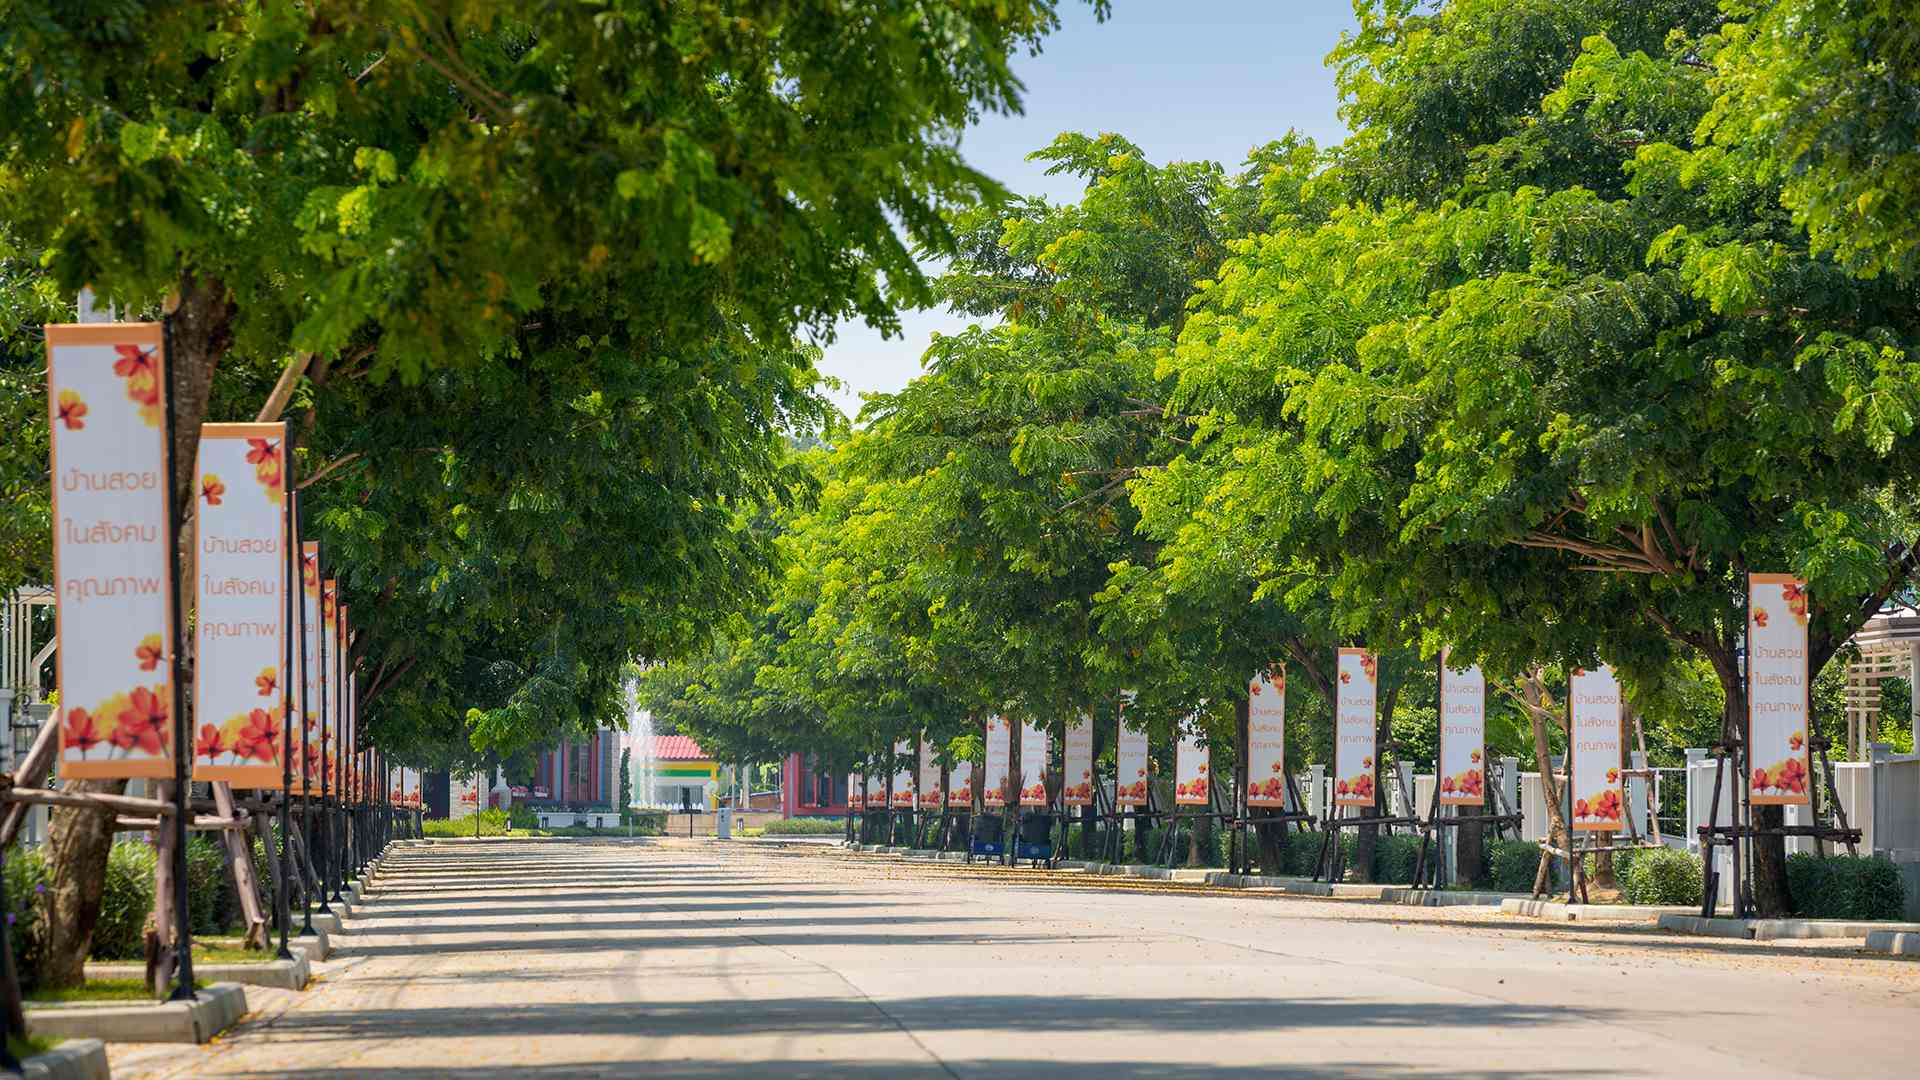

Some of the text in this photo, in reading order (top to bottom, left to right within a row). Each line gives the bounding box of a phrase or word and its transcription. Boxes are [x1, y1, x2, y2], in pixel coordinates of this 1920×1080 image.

[63, 466, 157, 492] บ้านสวย
[63, 517, 157, 544] ในสังคม
[203, 535, 277, 554] บ้านสวย
[65, 576, 160, 603] คุณภาพ
[202, 574, 275, 596] ในสังคม
[203, 622, 276, 641] คุณภาพ
[1755, 646, 1803, 660] บ้านสวย
[1755, 672, 1802, 686] ในสังคม
[1755, 702, 1803, 715] คุณภาพ
